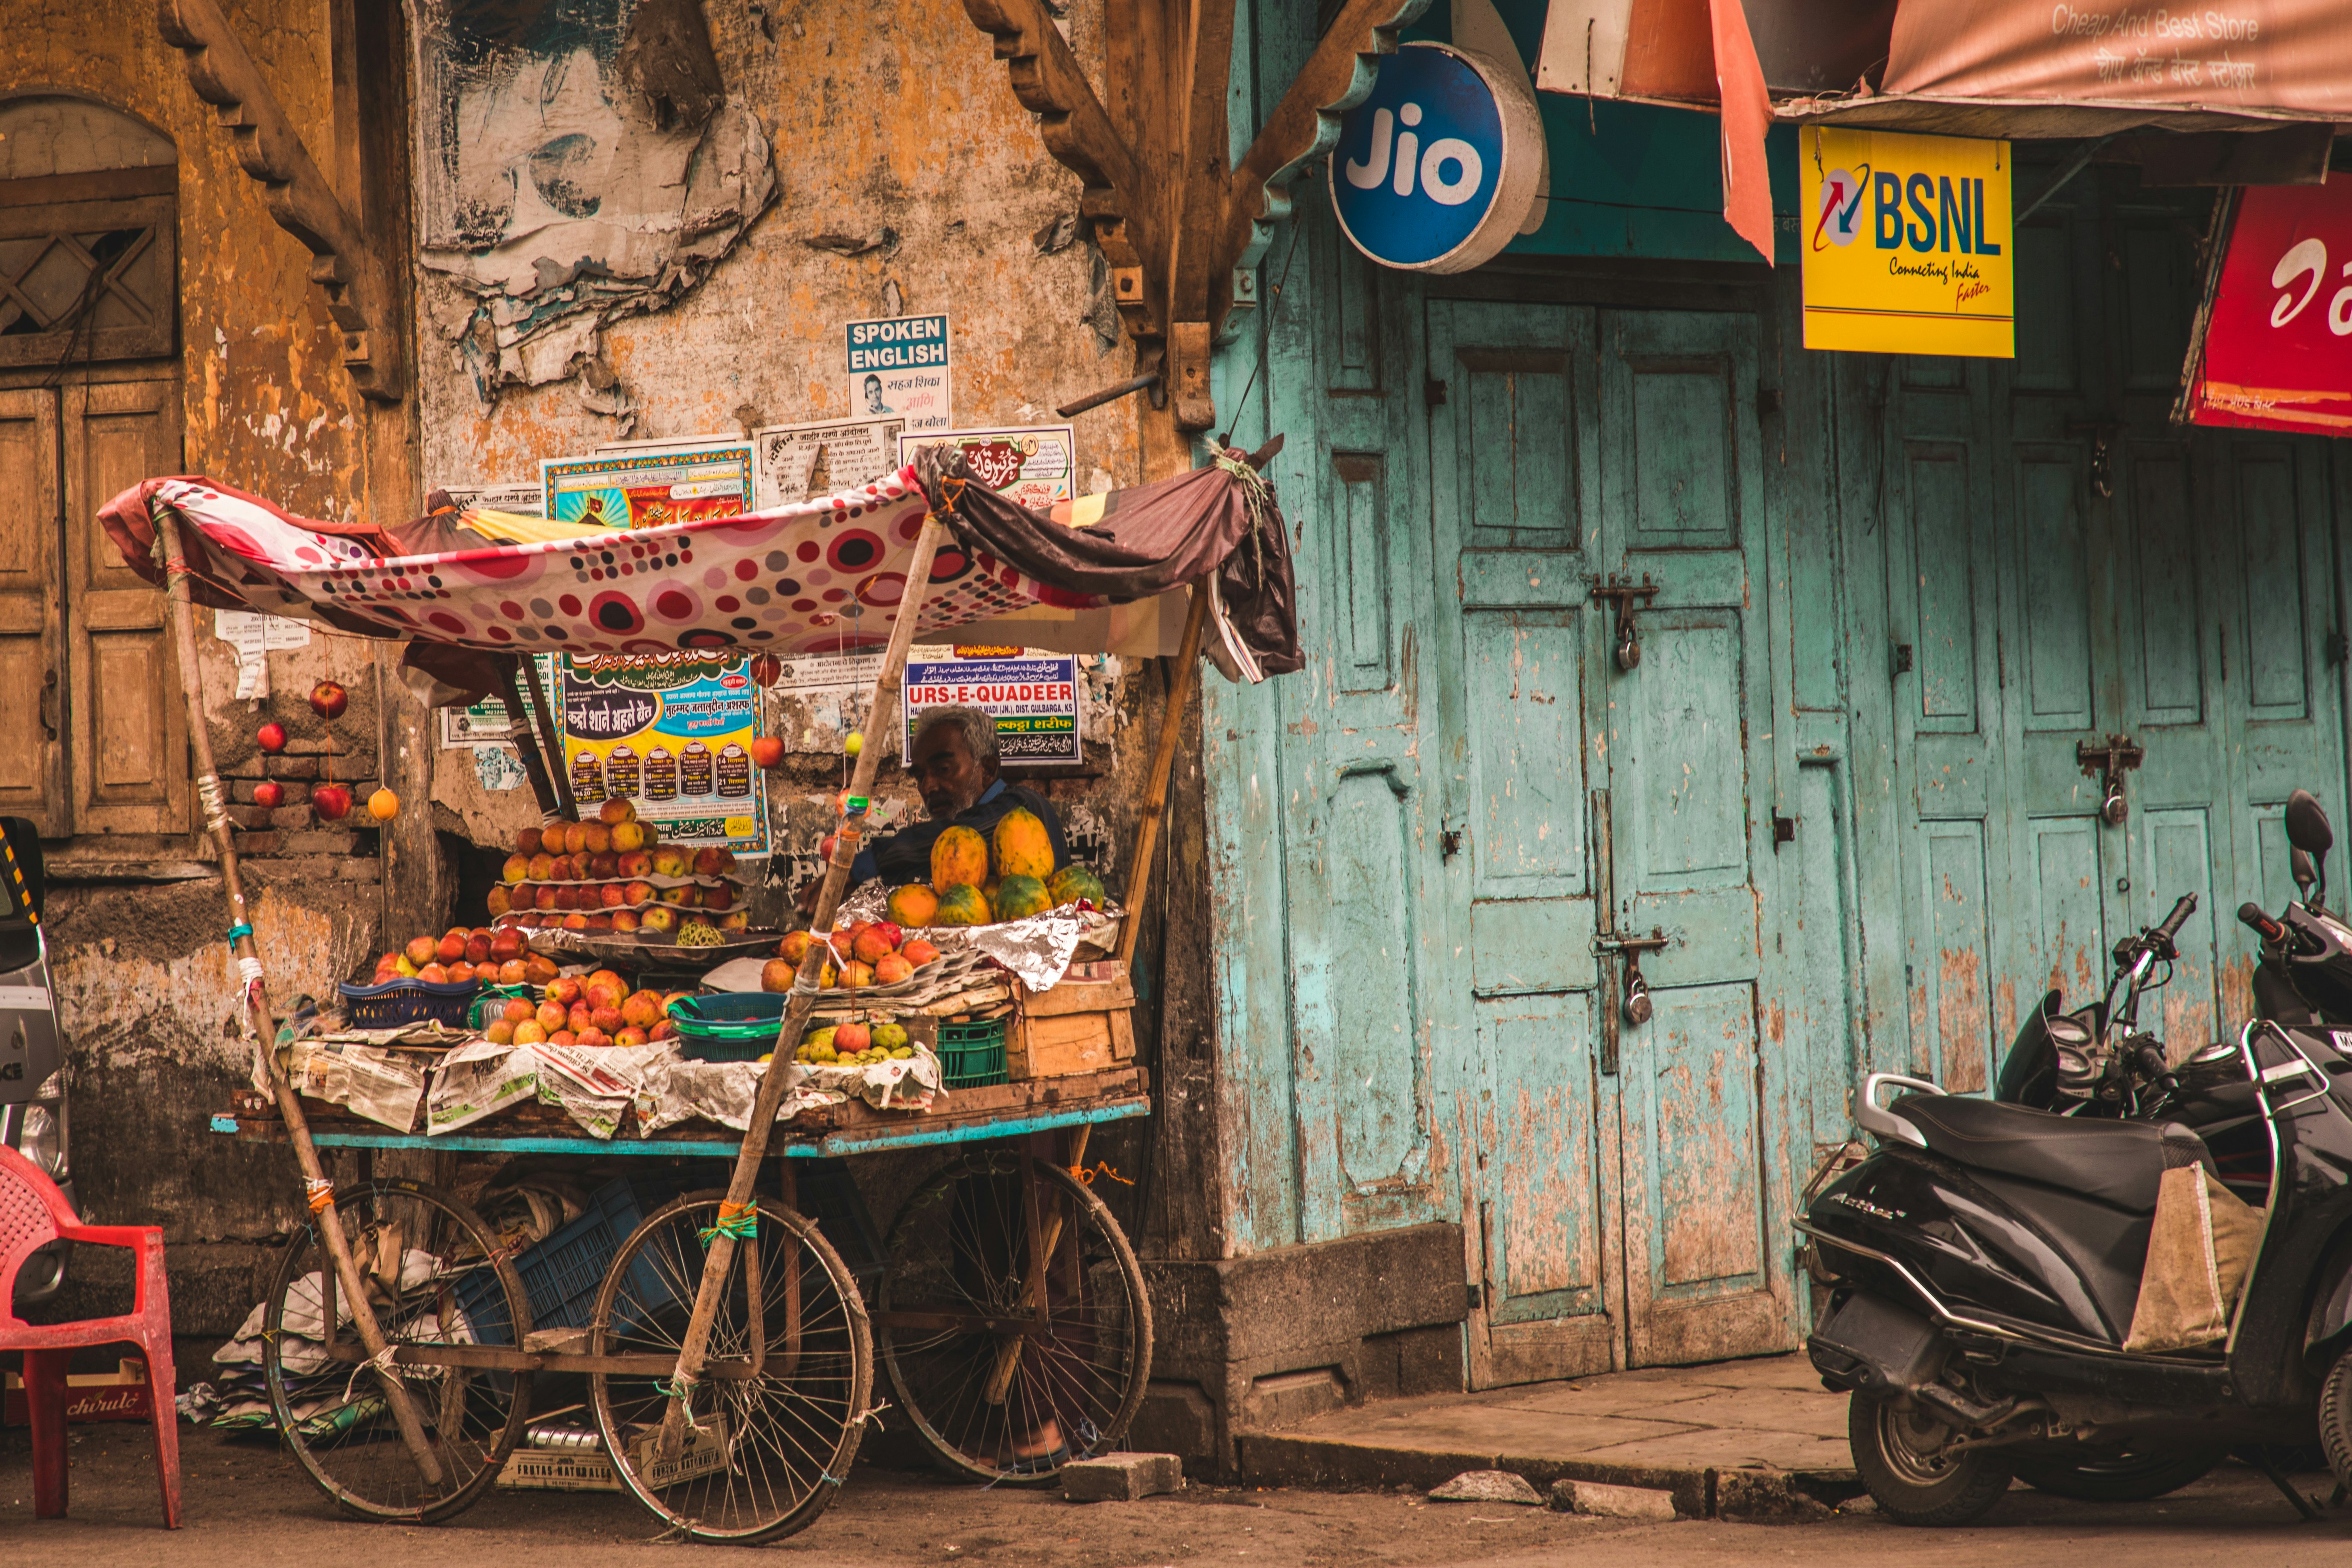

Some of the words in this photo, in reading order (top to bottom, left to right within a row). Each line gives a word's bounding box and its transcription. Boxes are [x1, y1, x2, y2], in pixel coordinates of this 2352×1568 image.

[2052, 4, 2110, 42] Cheap
[2110, 8, 2149, 37] And
[2155, 9, 2203, 38] Best
[2206, 12, 2259, 41] Store
[2170, 48, 2203, 85] बेस्ट
[1346, 102, 1482, 205] Jio
[1874, 172, 2001, 255] BSNL
[1890, 257, 1947, 285] Connecting
[1952, 260, 1980, 279] India
[853, 319, 940, 344] SPOKEN
[852, 343, 944, 369] ENGLISH
[888, 378, 912, 391] सहज
[915, 376, 940, 388] शिका
[906, 393, 934, 411] आणि
[925, 415, 947, 428] बोला
[909, 684, 1072, 704] URS-E-QUADEER
[612, 699, 635, 733] अहले
[637, 699, 652, 724] बैत
[665, 703, 690, 719] मुहम्मद
[690, 697, 724, 717] जलालुद्दीन
[725, 699, 750, 710] अशरफ
[984, 705, 998, 714] WADI
[1000, 704, 1014, 715] (JN.),
[1016, 704, 1029, 714] DIST.
[1031, 704, 1063, 714] GULBARGA,
[1065, 704, 1072, 712] KS
[997, 720, 1029, 732] ल्कट्टा
[1034, 716, 1072, 729] शरीफ
[557, 1050, 581, 1067] citizens
[361, 1066, 372, 1075] Shah
[518, 1465, 552, 1476] FRUTAS
[557, 1466, 612, 1478] NATURALES
[652, 1462, 678, 1478] FRUTAS
[681, 1450, 719, 1471] NATURALES
